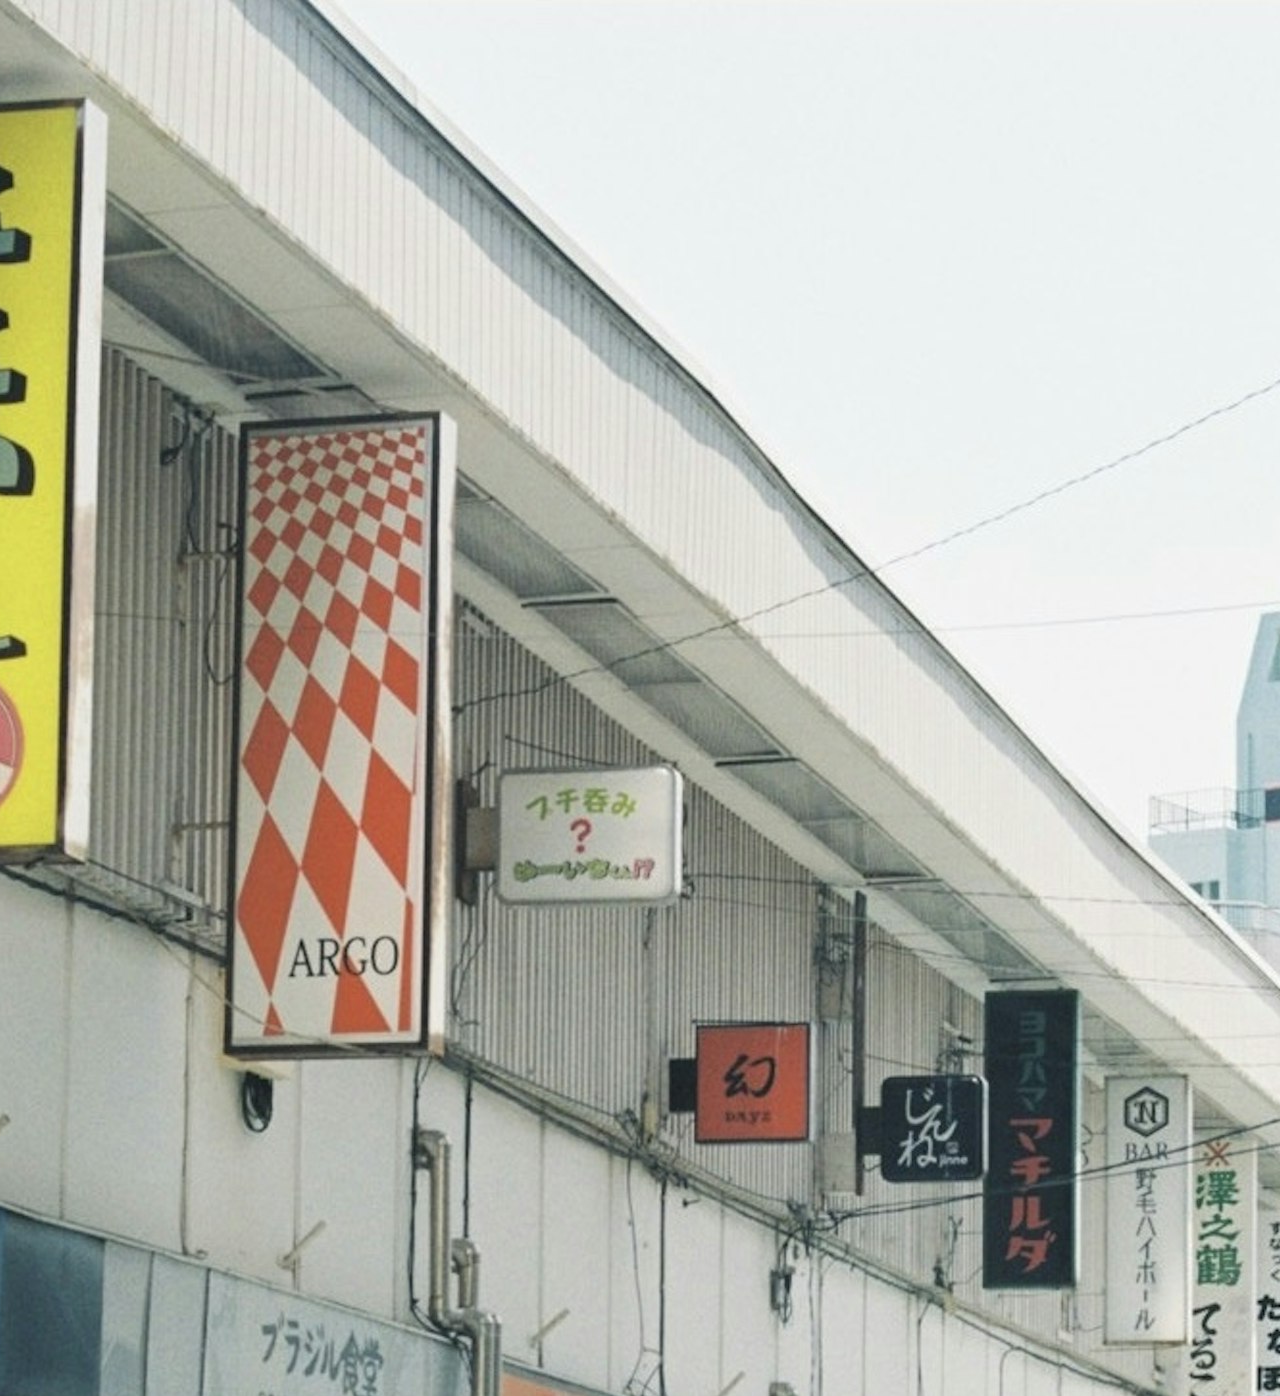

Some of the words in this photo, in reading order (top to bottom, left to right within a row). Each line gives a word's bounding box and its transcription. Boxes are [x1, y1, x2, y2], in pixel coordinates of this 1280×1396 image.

[288, 935, 400, 979] ARGO
[724, 1053, 777, 1098] 幻
[1017, 1010, 1048, 1112] ヨコハマ
[897, 1084, 958, 1168] じんね
[1125, 1142, 1169, 1161] BAR
[1005, 1117, 1058, 1273] マチルダ
